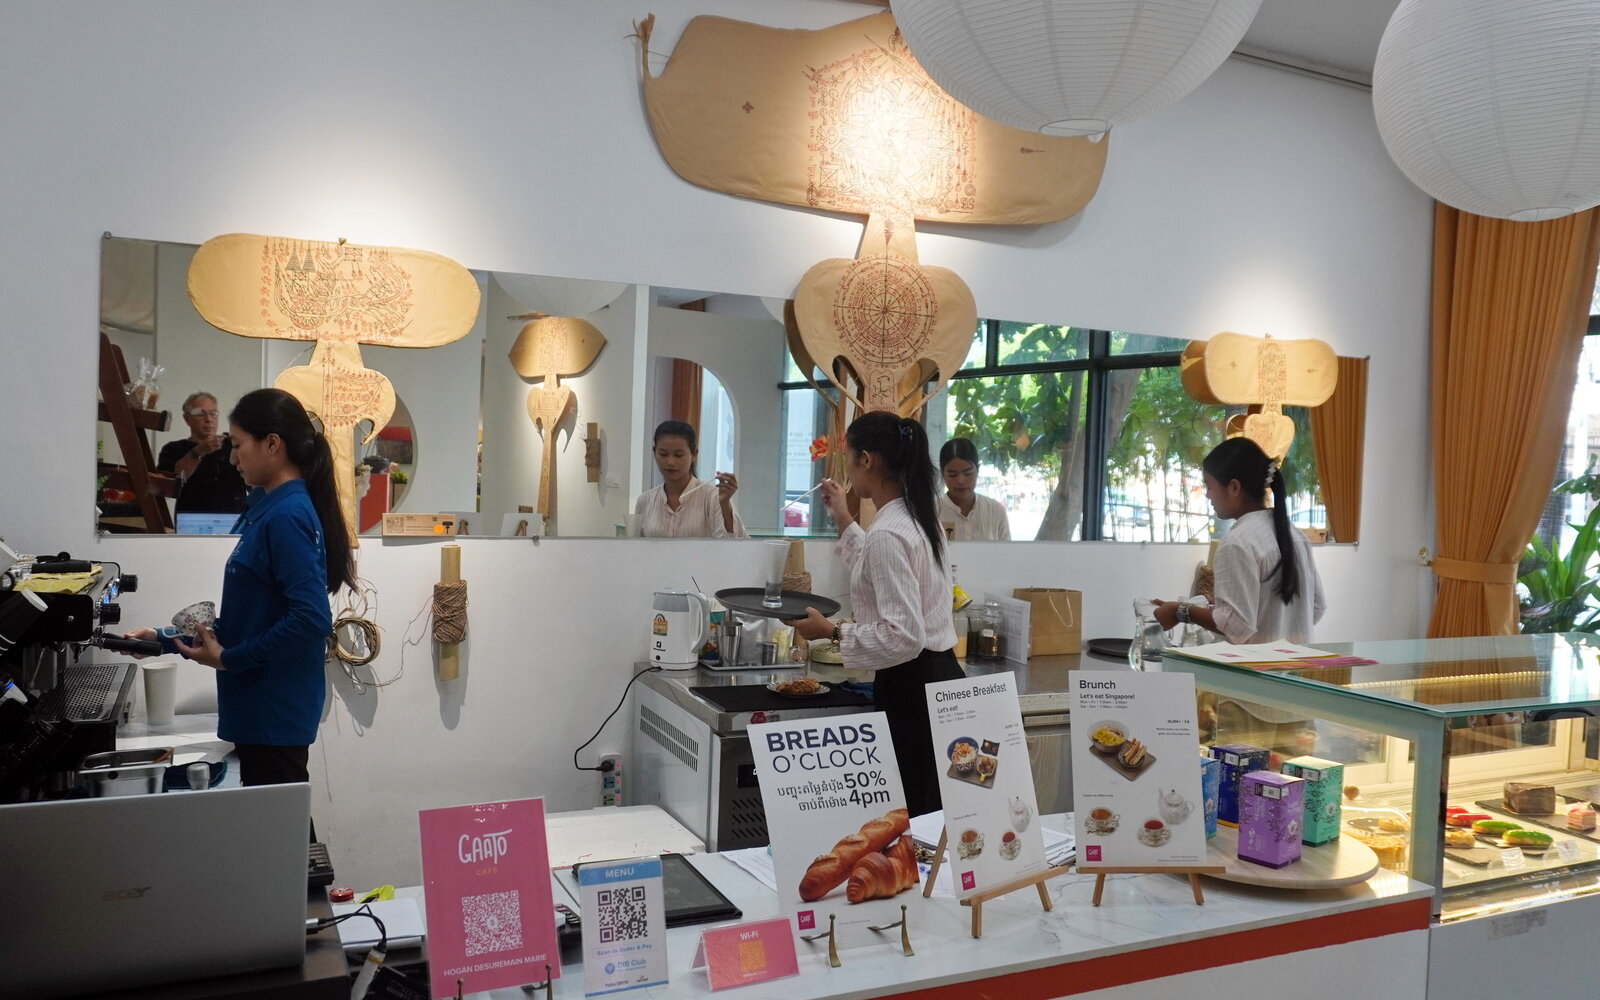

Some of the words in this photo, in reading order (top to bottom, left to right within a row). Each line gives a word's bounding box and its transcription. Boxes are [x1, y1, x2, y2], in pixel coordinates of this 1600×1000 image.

[936, 690, 971, 702] Chinese
[973, 683, 1006, 696] Breakfast
[1079, 680, 1116, 689] Brunch
[766, 723, 876, 752] BREADS
[773, 747, 881, 772] O'CLOCK
[843, 770, 887, 789] 50%
[849, 789, 891, 808] 4pm
[458, 829, 512, 864] GAATO
[606, 867, 634, 878] MENU
[443, 966, 473, 976] HOGAN
[474, 959, 523, 972] DESUREMAIN
[524, 953, 547, 963] MARIE
[631, 958, 647, 966] Club
